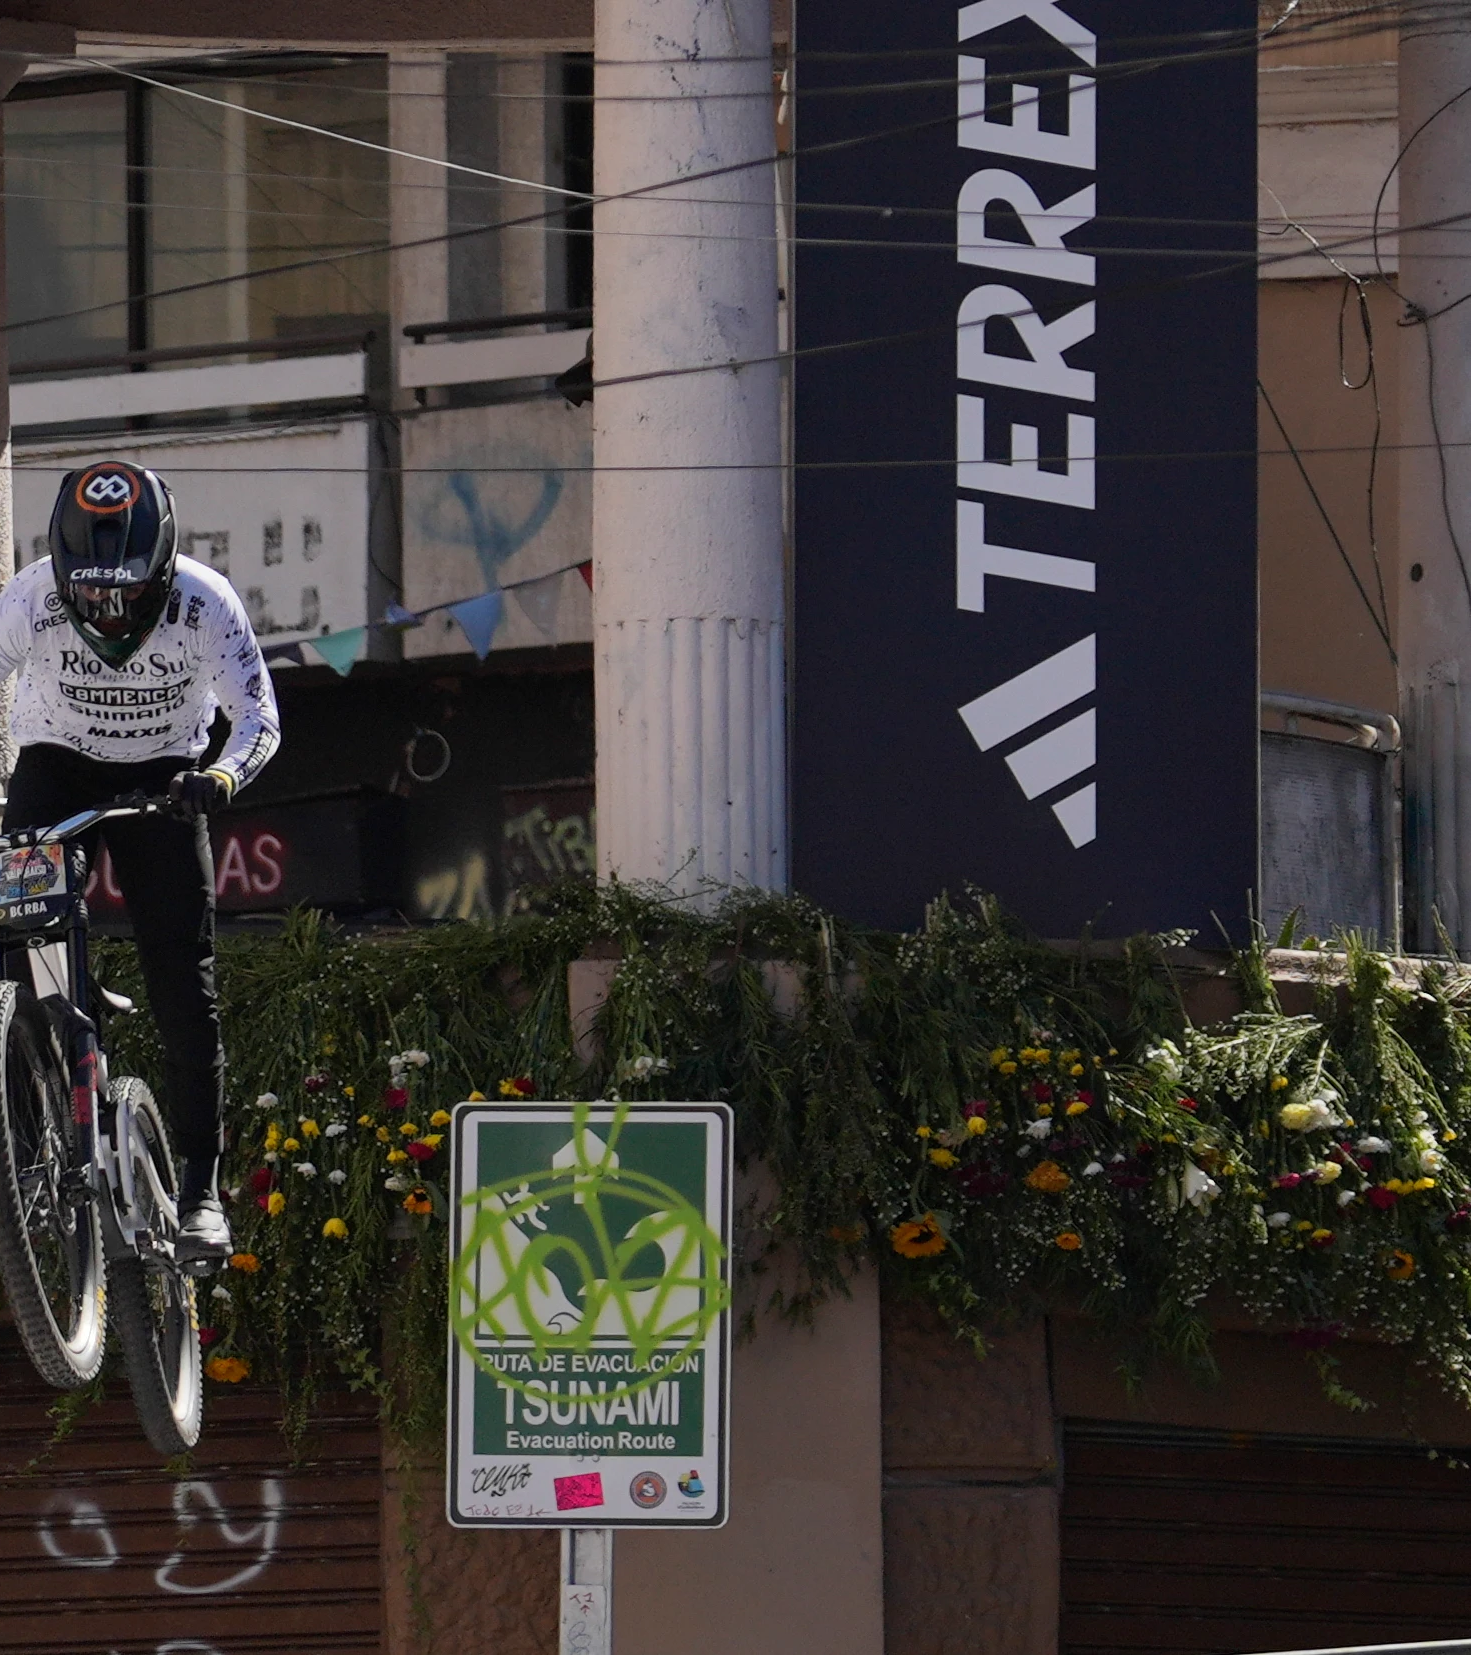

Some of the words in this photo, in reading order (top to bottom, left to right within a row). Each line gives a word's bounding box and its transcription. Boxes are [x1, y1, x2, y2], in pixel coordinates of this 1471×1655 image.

[70, 566, 138, 581] CRESOL
[59, 650, 102, 675] Rio
[540, 1354, 566, 1373] DE
[498, 1380, 679, 1426] TSUNAMI
[506, 1431, 614, 1450] Evacuation
[618, 1431, 676, 1450] Route
